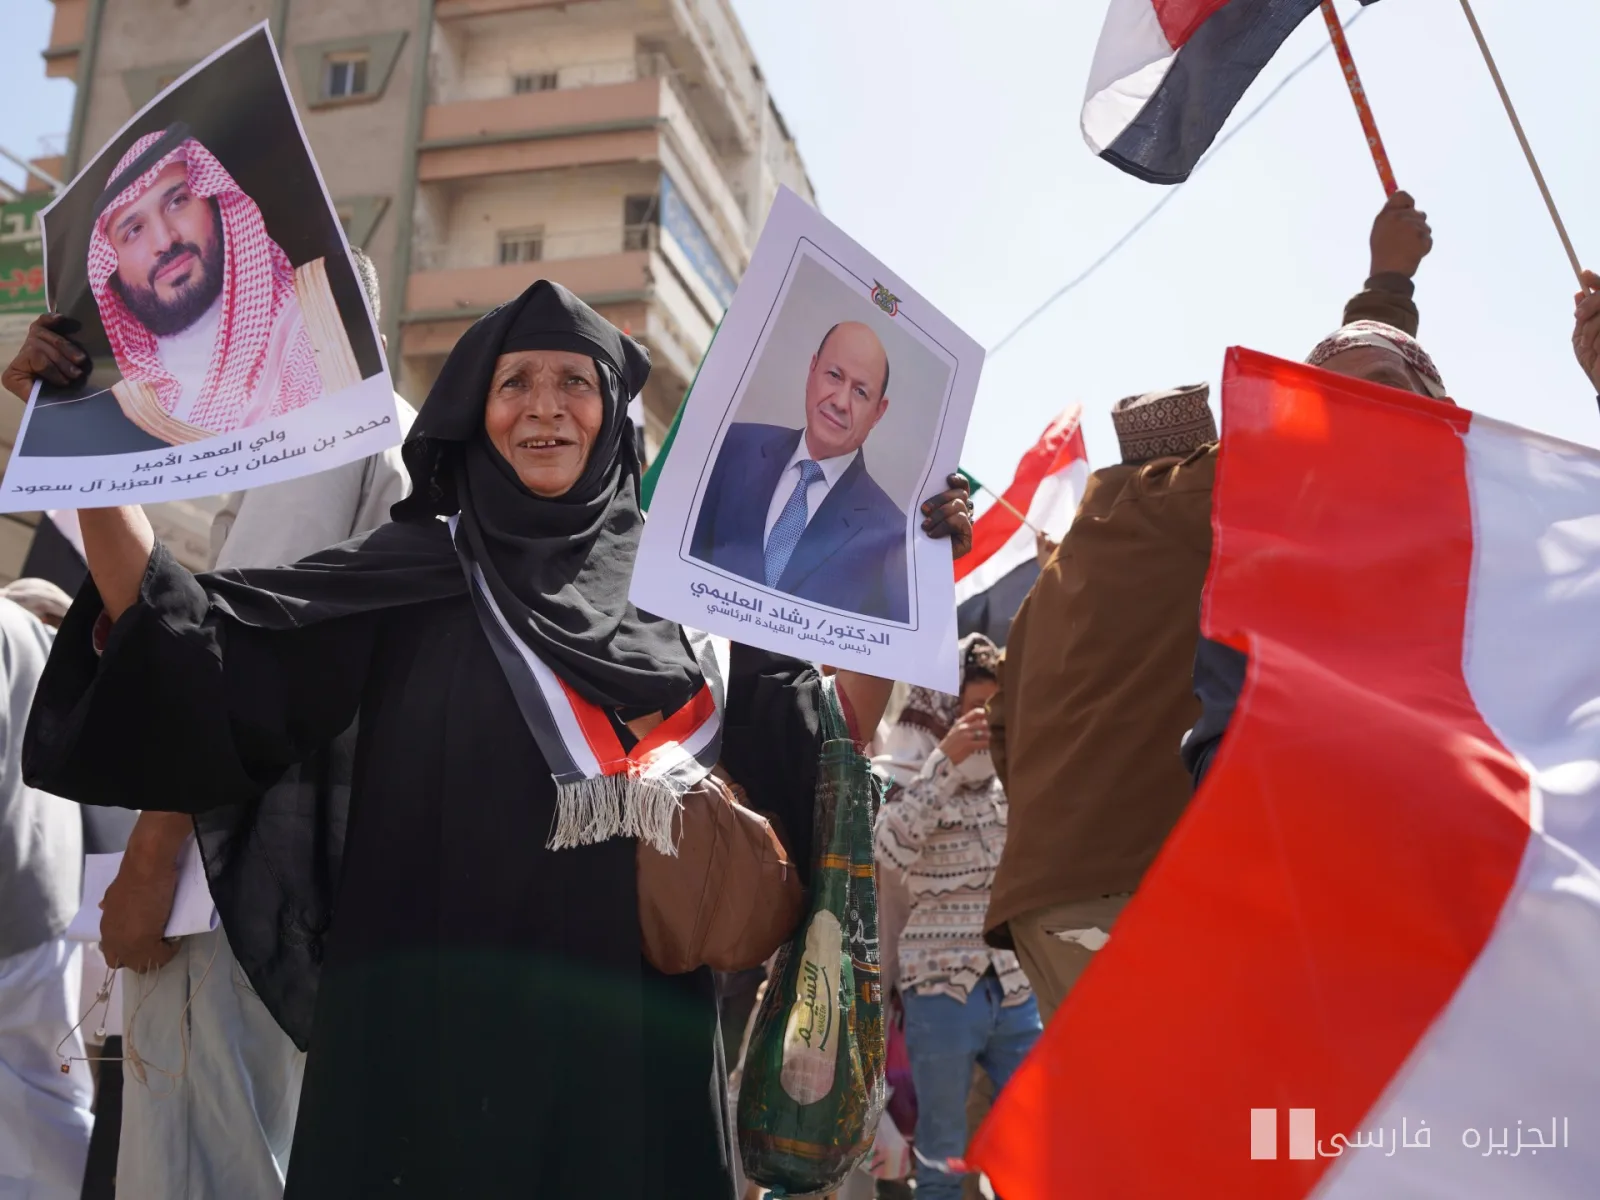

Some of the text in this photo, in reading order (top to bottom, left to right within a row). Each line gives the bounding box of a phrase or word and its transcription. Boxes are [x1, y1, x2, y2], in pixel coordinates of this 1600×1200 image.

[11, 414, 391, 495] محمد بن سلمان بن عبد العزيز آل سعود
[132, 430, 286, 473] ولي العهد الأمير
[690, 580, 763, 613] العليمي
[768, 606, 811, 629] رشاد
[706, 603, 872, 655] رئيس مجلس القيادة الرئاسي
